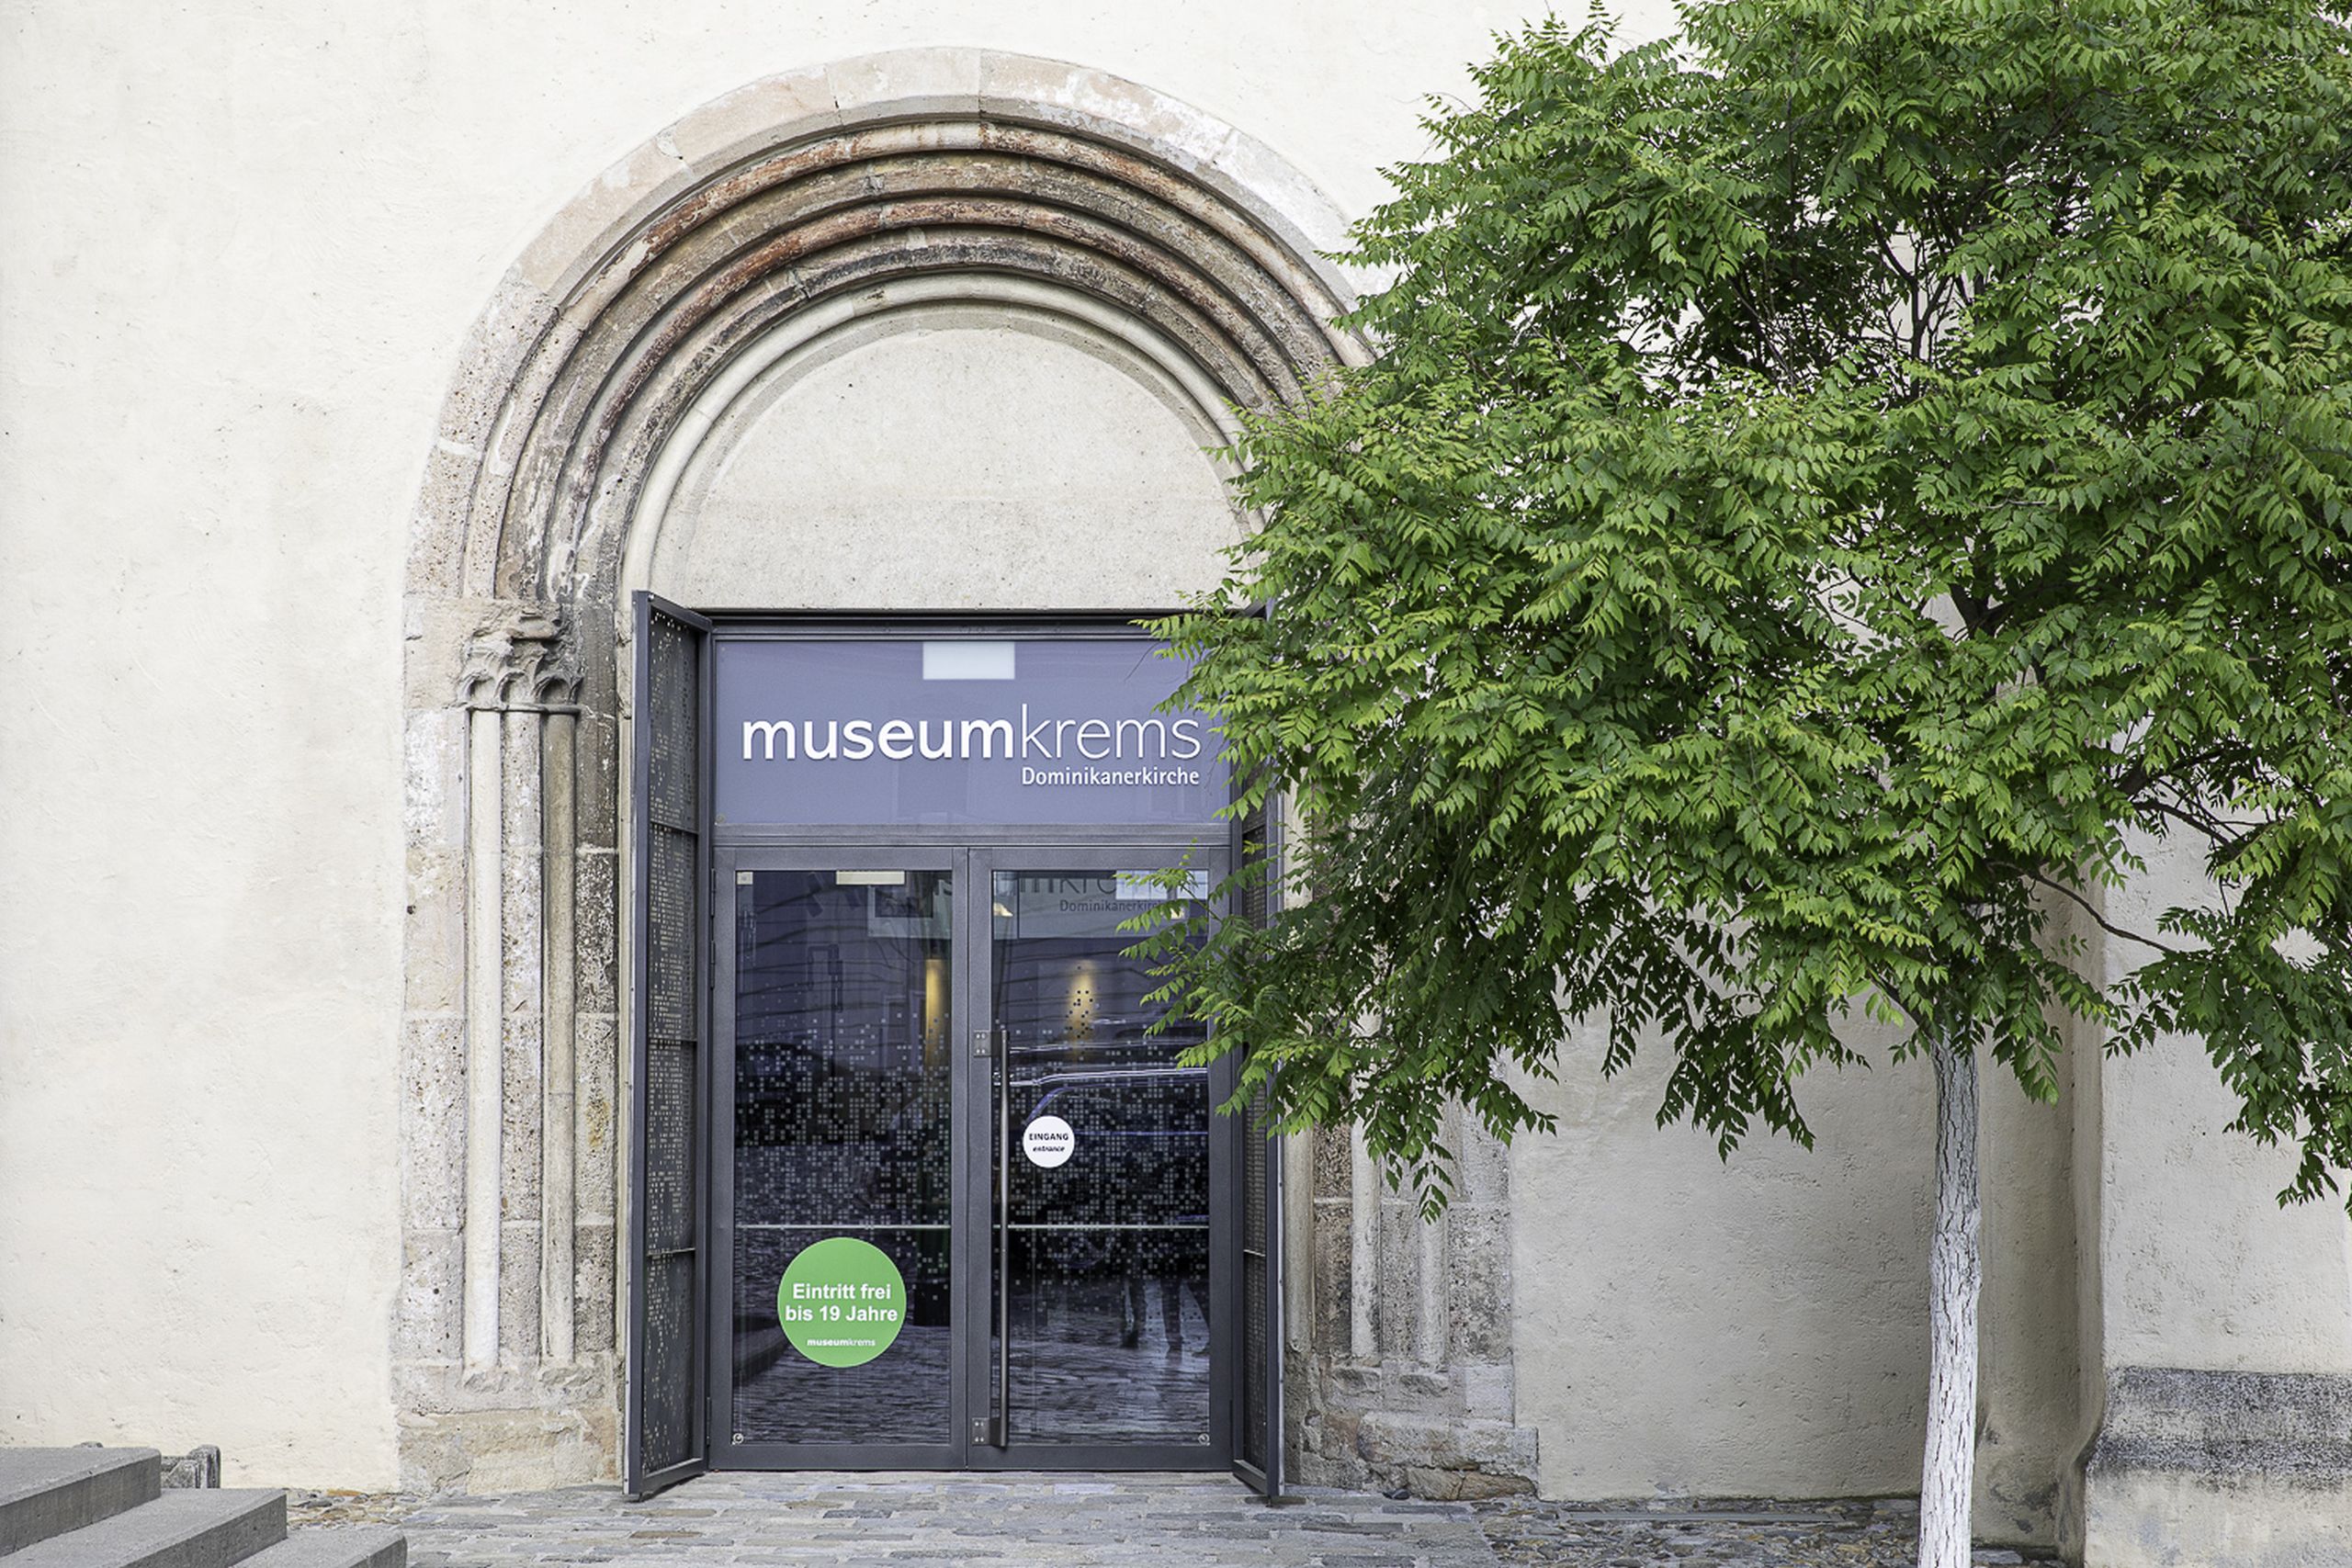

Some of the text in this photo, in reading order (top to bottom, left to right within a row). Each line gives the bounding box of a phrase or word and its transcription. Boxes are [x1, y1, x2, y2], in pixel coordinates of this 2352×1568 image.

[742, 704, 1202, 760] museumkrems
[1021, 768, 1200, 786] Dominikanerkirche
[1059, 898, 1161, 912] Dominikanerkirc
[1029, 1133, 1069, 1141] EINGANG
[793, 1283, 891, 1299] Eintritt frei
[785, 1305, 898, 1321] bis 19 Jahre
[807, 1337, 876, 1347] museumkrems
